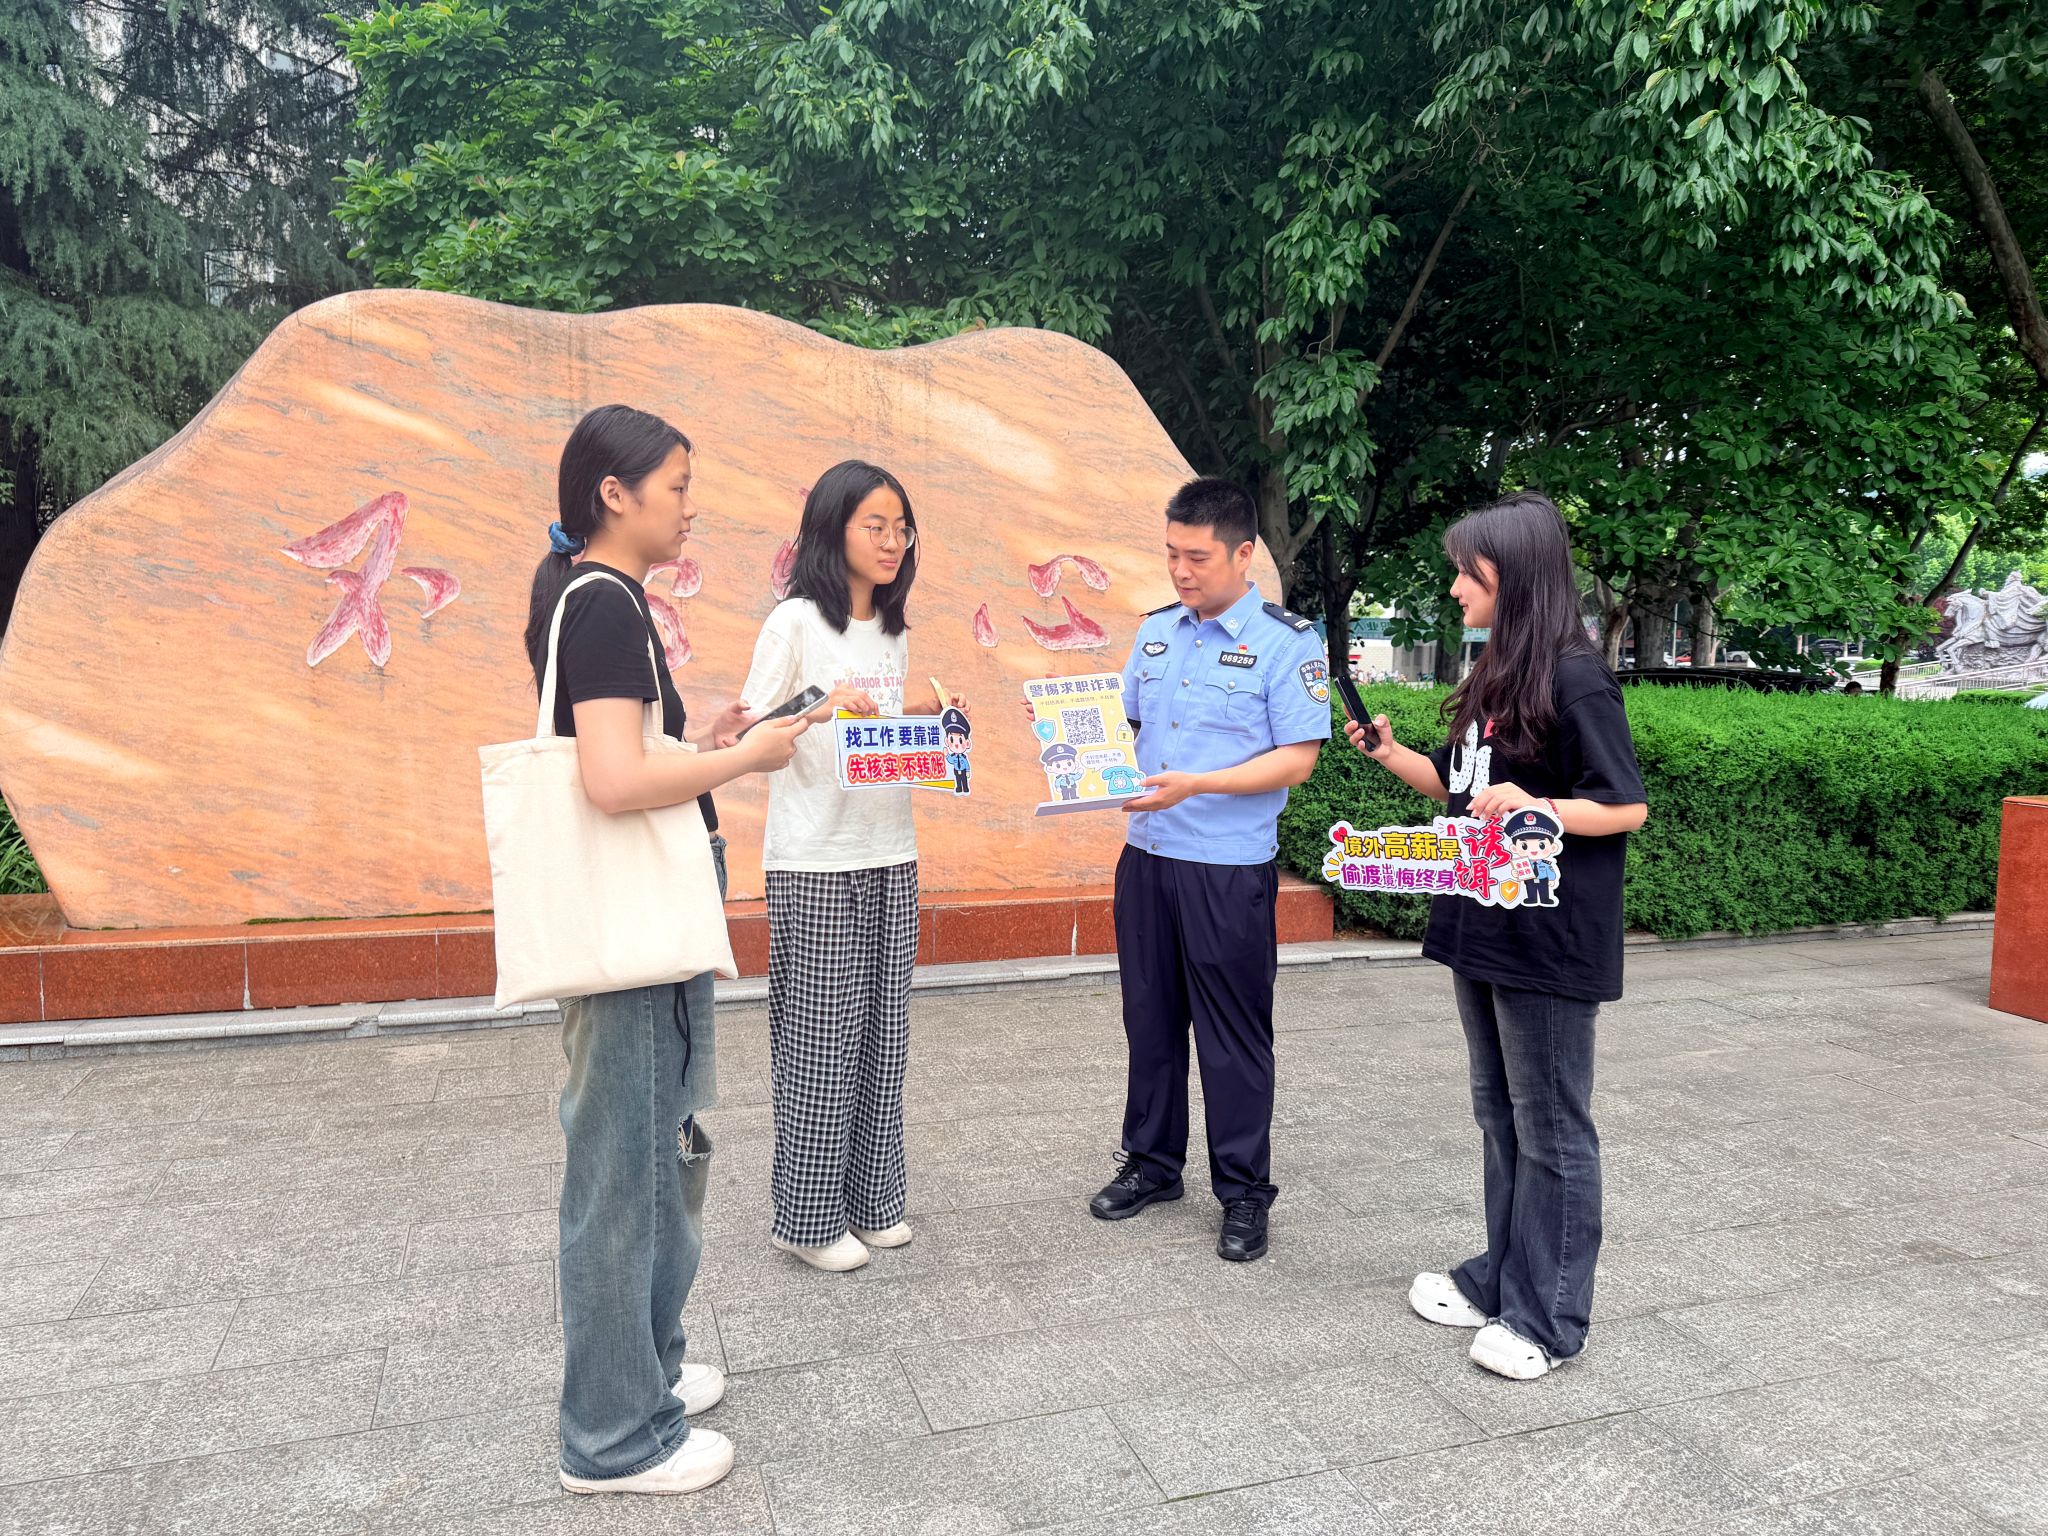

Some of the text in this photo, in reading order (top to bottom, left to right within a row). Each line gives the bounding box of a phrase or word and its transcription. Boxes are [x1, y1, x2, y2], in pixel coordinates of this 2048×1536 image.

[1222, 655, 1254, 665] 069256
[883, 676, 904, 688] STA
[1029, 678, 1120, 697] 警惕求职诈骗
